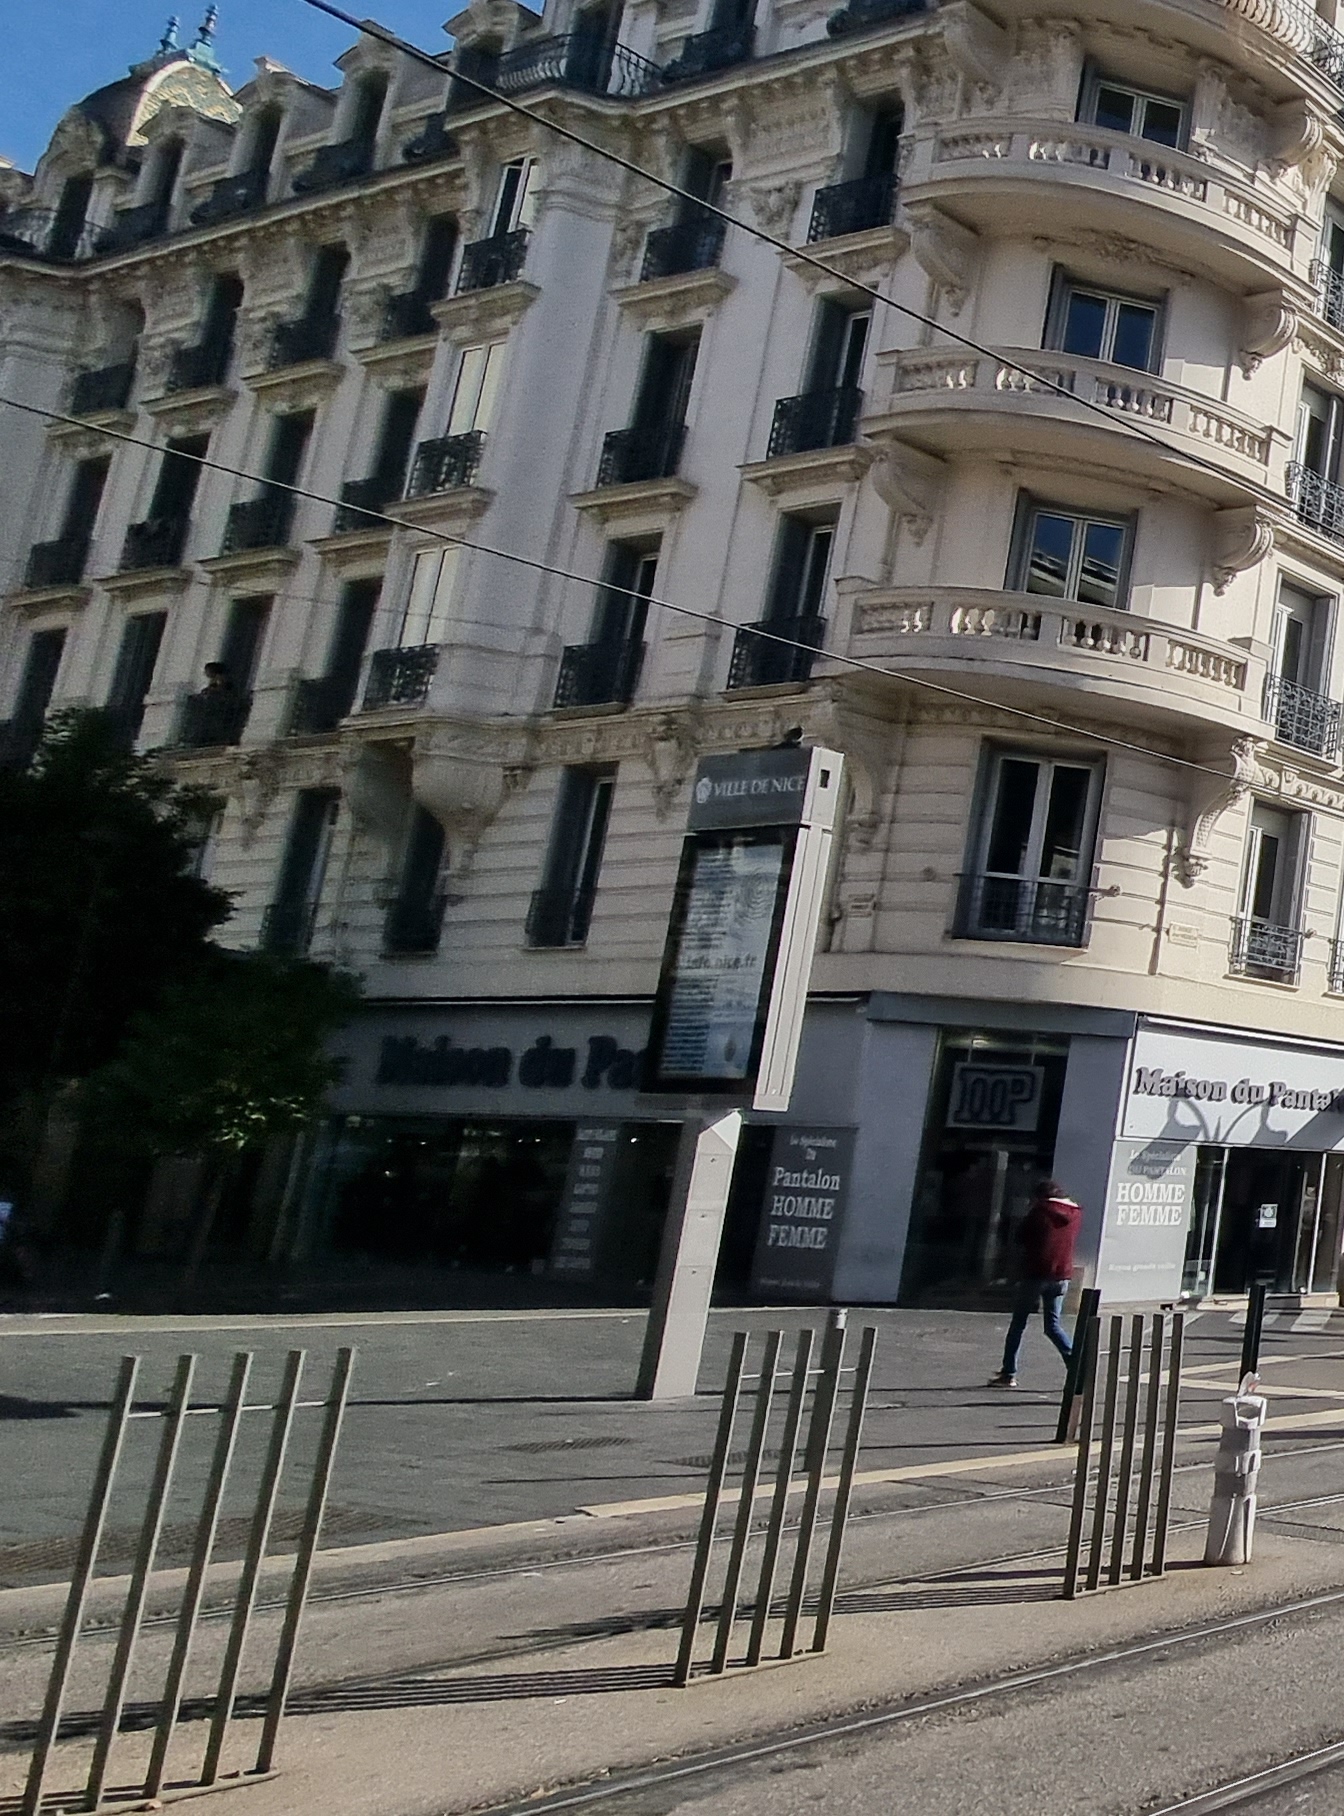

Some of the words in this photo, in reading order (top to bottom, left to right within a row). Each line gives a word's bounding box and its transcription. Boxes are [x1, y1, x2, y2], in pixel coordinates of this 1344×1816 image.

[714, 781, 748, 796] VILLE
[751, 780, 769, 794] DE
[772, 776, 805, 793] NICE
[1133, 1067, 1227, 1100] Maison
[1232, 1078, 1265, 1105] du
[772, 1166, 841, 1191] Pantalon
[1116, 1183, 1186, 1203] HOMME
[770, 1195, 835, 1220] HOMME
[1116, 1205, 1182, 1226] FEMME
[767, 1224, 828, 1250] FEMME
